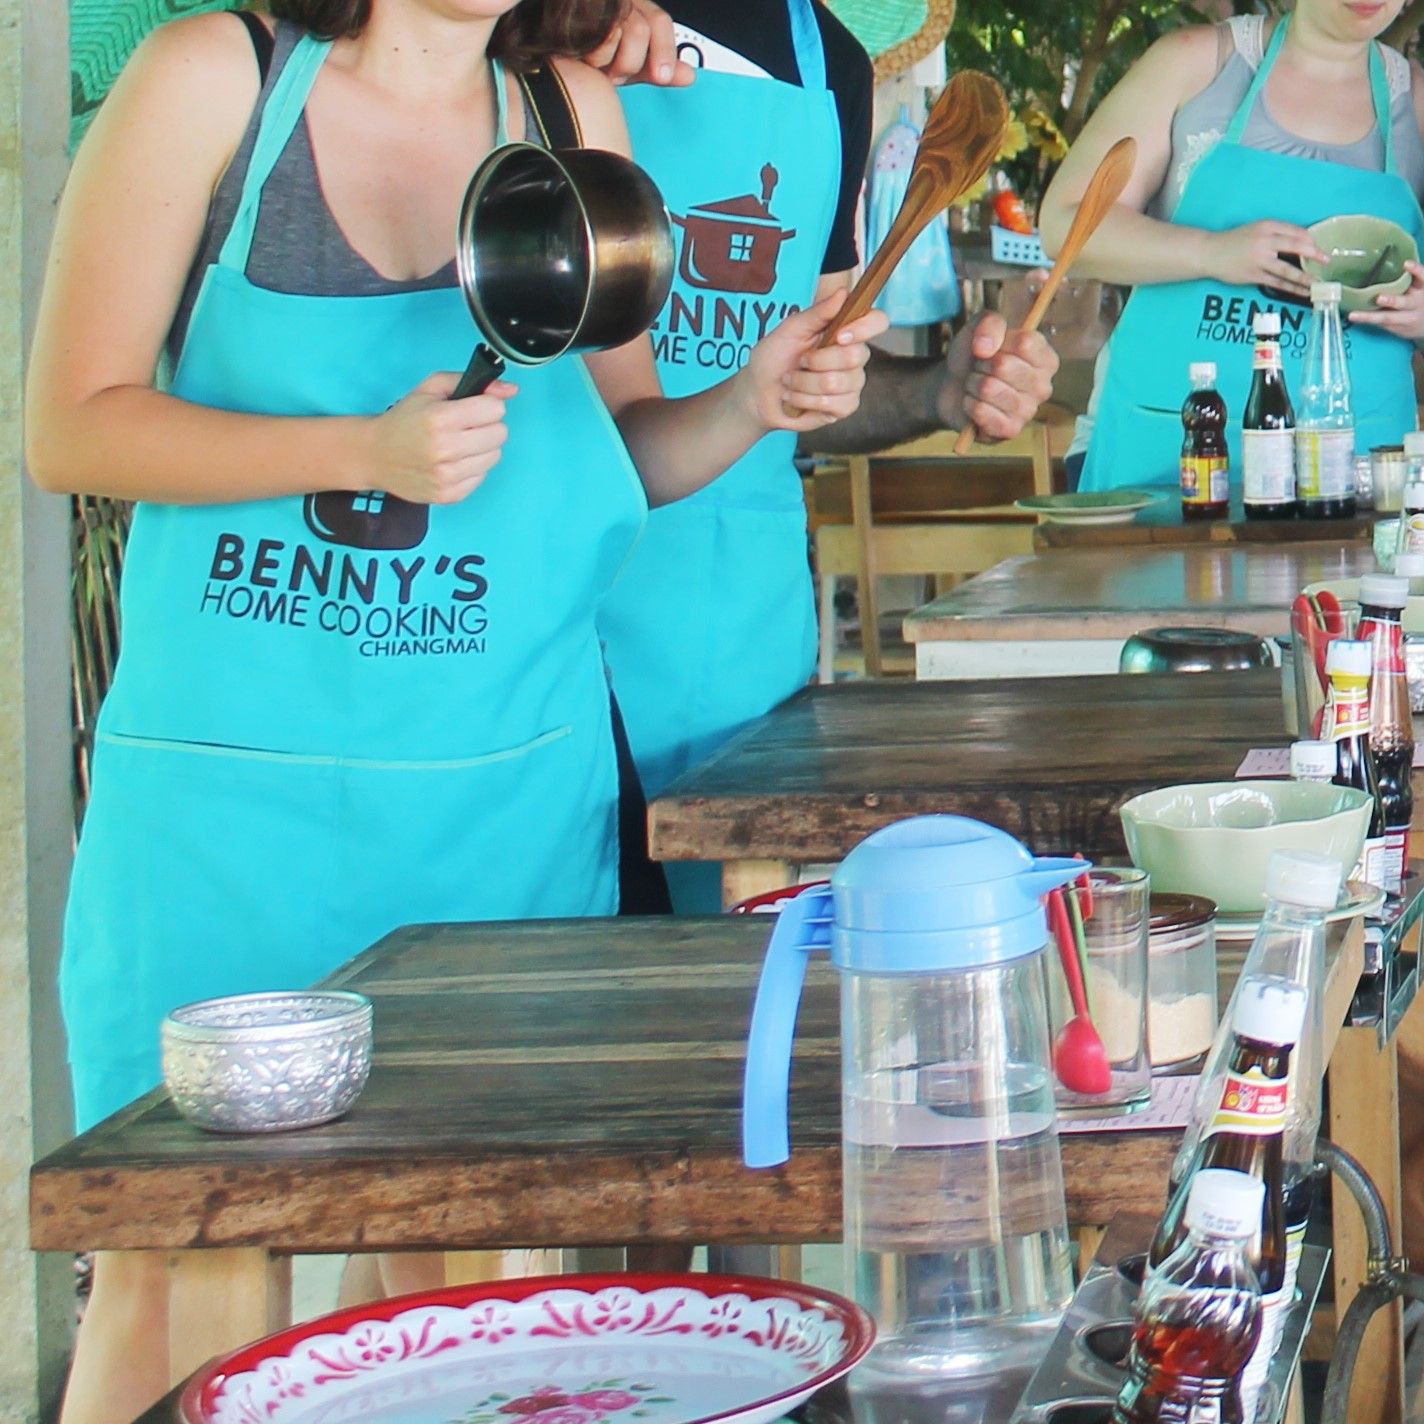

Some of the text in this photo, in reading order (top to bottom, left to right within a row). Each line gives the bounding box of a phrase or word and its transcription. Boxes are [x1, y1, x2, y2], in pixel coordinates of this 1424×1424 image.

[208, 532, 489, 606] BENNY'S
[199, 582, 312, 627] HOME
[358, 637, 487, 657] CHIANGMAI
